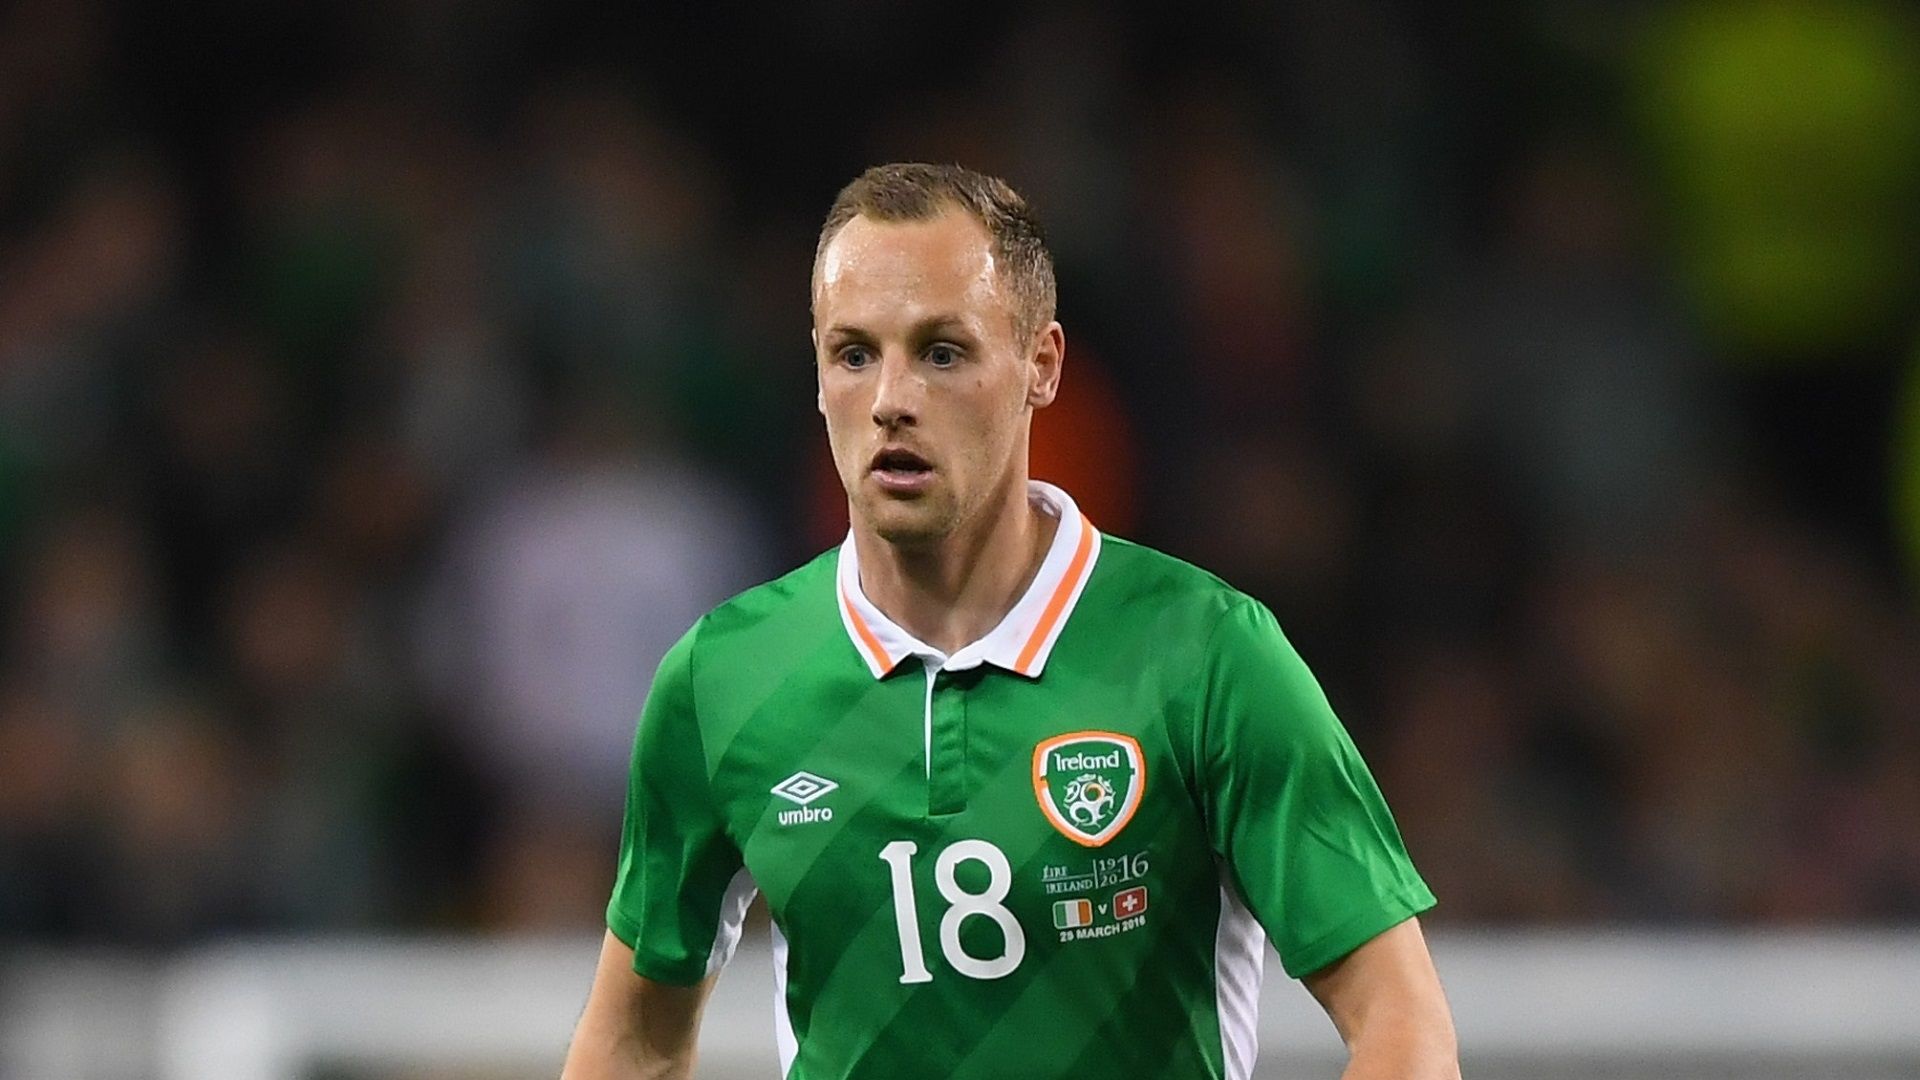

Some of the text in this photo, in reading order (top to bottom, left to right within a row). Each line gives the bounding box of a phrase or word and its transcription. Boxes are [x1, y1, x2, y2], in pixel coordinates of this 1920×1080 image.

[1054, 750, 1119, 772] Ireland
[778, 806, 833, 825] umbro
[1099, 858, 1116, 872] 19
[1117, 850, 1149, 882] 16
[1046, 879, 1093, 894] IRELAND
[1100, 874, 1117, 887] 20
[878, 839, 1026, 984] 18
[1076, 924, 1120, 939] MARCH
[1122, 915, 1146, 932] 2016
